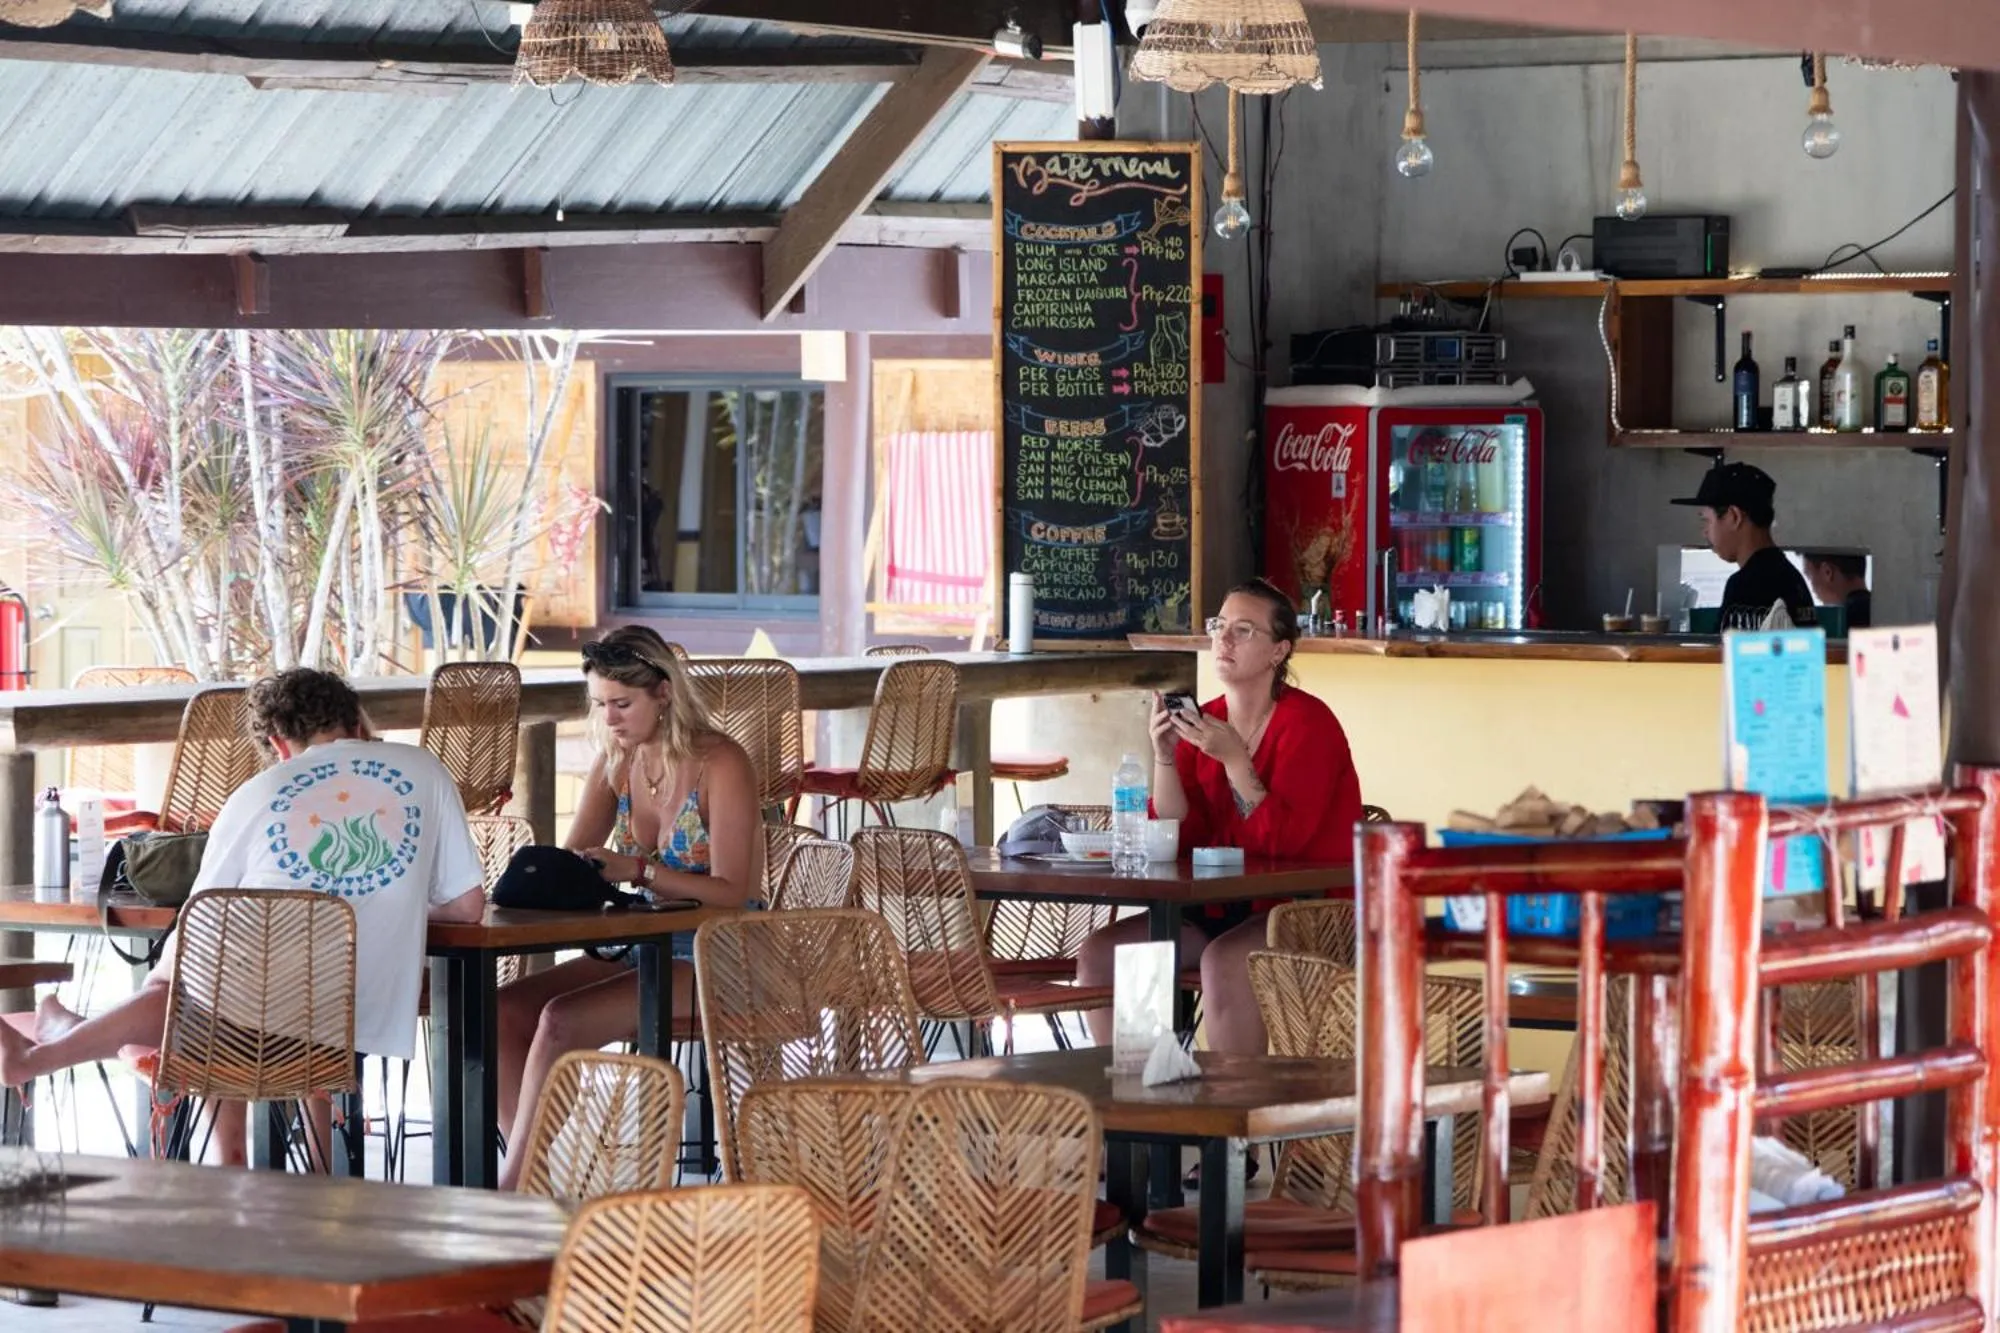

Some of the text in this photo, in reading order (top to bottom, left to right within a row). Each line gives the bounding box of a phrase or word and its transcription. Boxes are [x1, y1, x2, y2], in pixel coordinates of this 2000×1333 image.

[1015, 243, 1056, 257] RHUM
[1088, 243, 1120, 257] COKE
[1016, 257, 1107, 272] LONG ISLAND
[1016, 271, 1099, 287] MARGARITA
[1017, 287, 1071, 302] FROZEN
[1013, 302, 1092, 316] CAIPIRINHA
[1011, 316, 1095, 330] CAIPIROSKA
[1034, 348, 1102, 366] WINES
[1019, 366, 1048, 381] PER
[1055, 367, 1100, 382] GLASS
[1019, 382, 1050, 397] PER
[1056, 382, 1105, 397] BOTTLE
[1021, 434, 1103, 451] RED HORSE
[1274, 422, 1357, 472] Coca-Cola
[1019, 449, 1045, 462] SAN
[1016, 463, 1045, 476] SAN
[1083, 466, 1119, 477] LIGHT
[1016, 475, 1045, 489] SAN
[1016, 487, 1044, 500] SAN
[1024, 543, 1044, 558] ICE
[1051, 546, 1100, 562] COFFEE
[1034, 571, 1098, 586] SPRESSO
[1033, 586, 1106, 600] MERICANO
[271, 763, 339, 812] GROW
[352, 759, 414, 796] INTO
